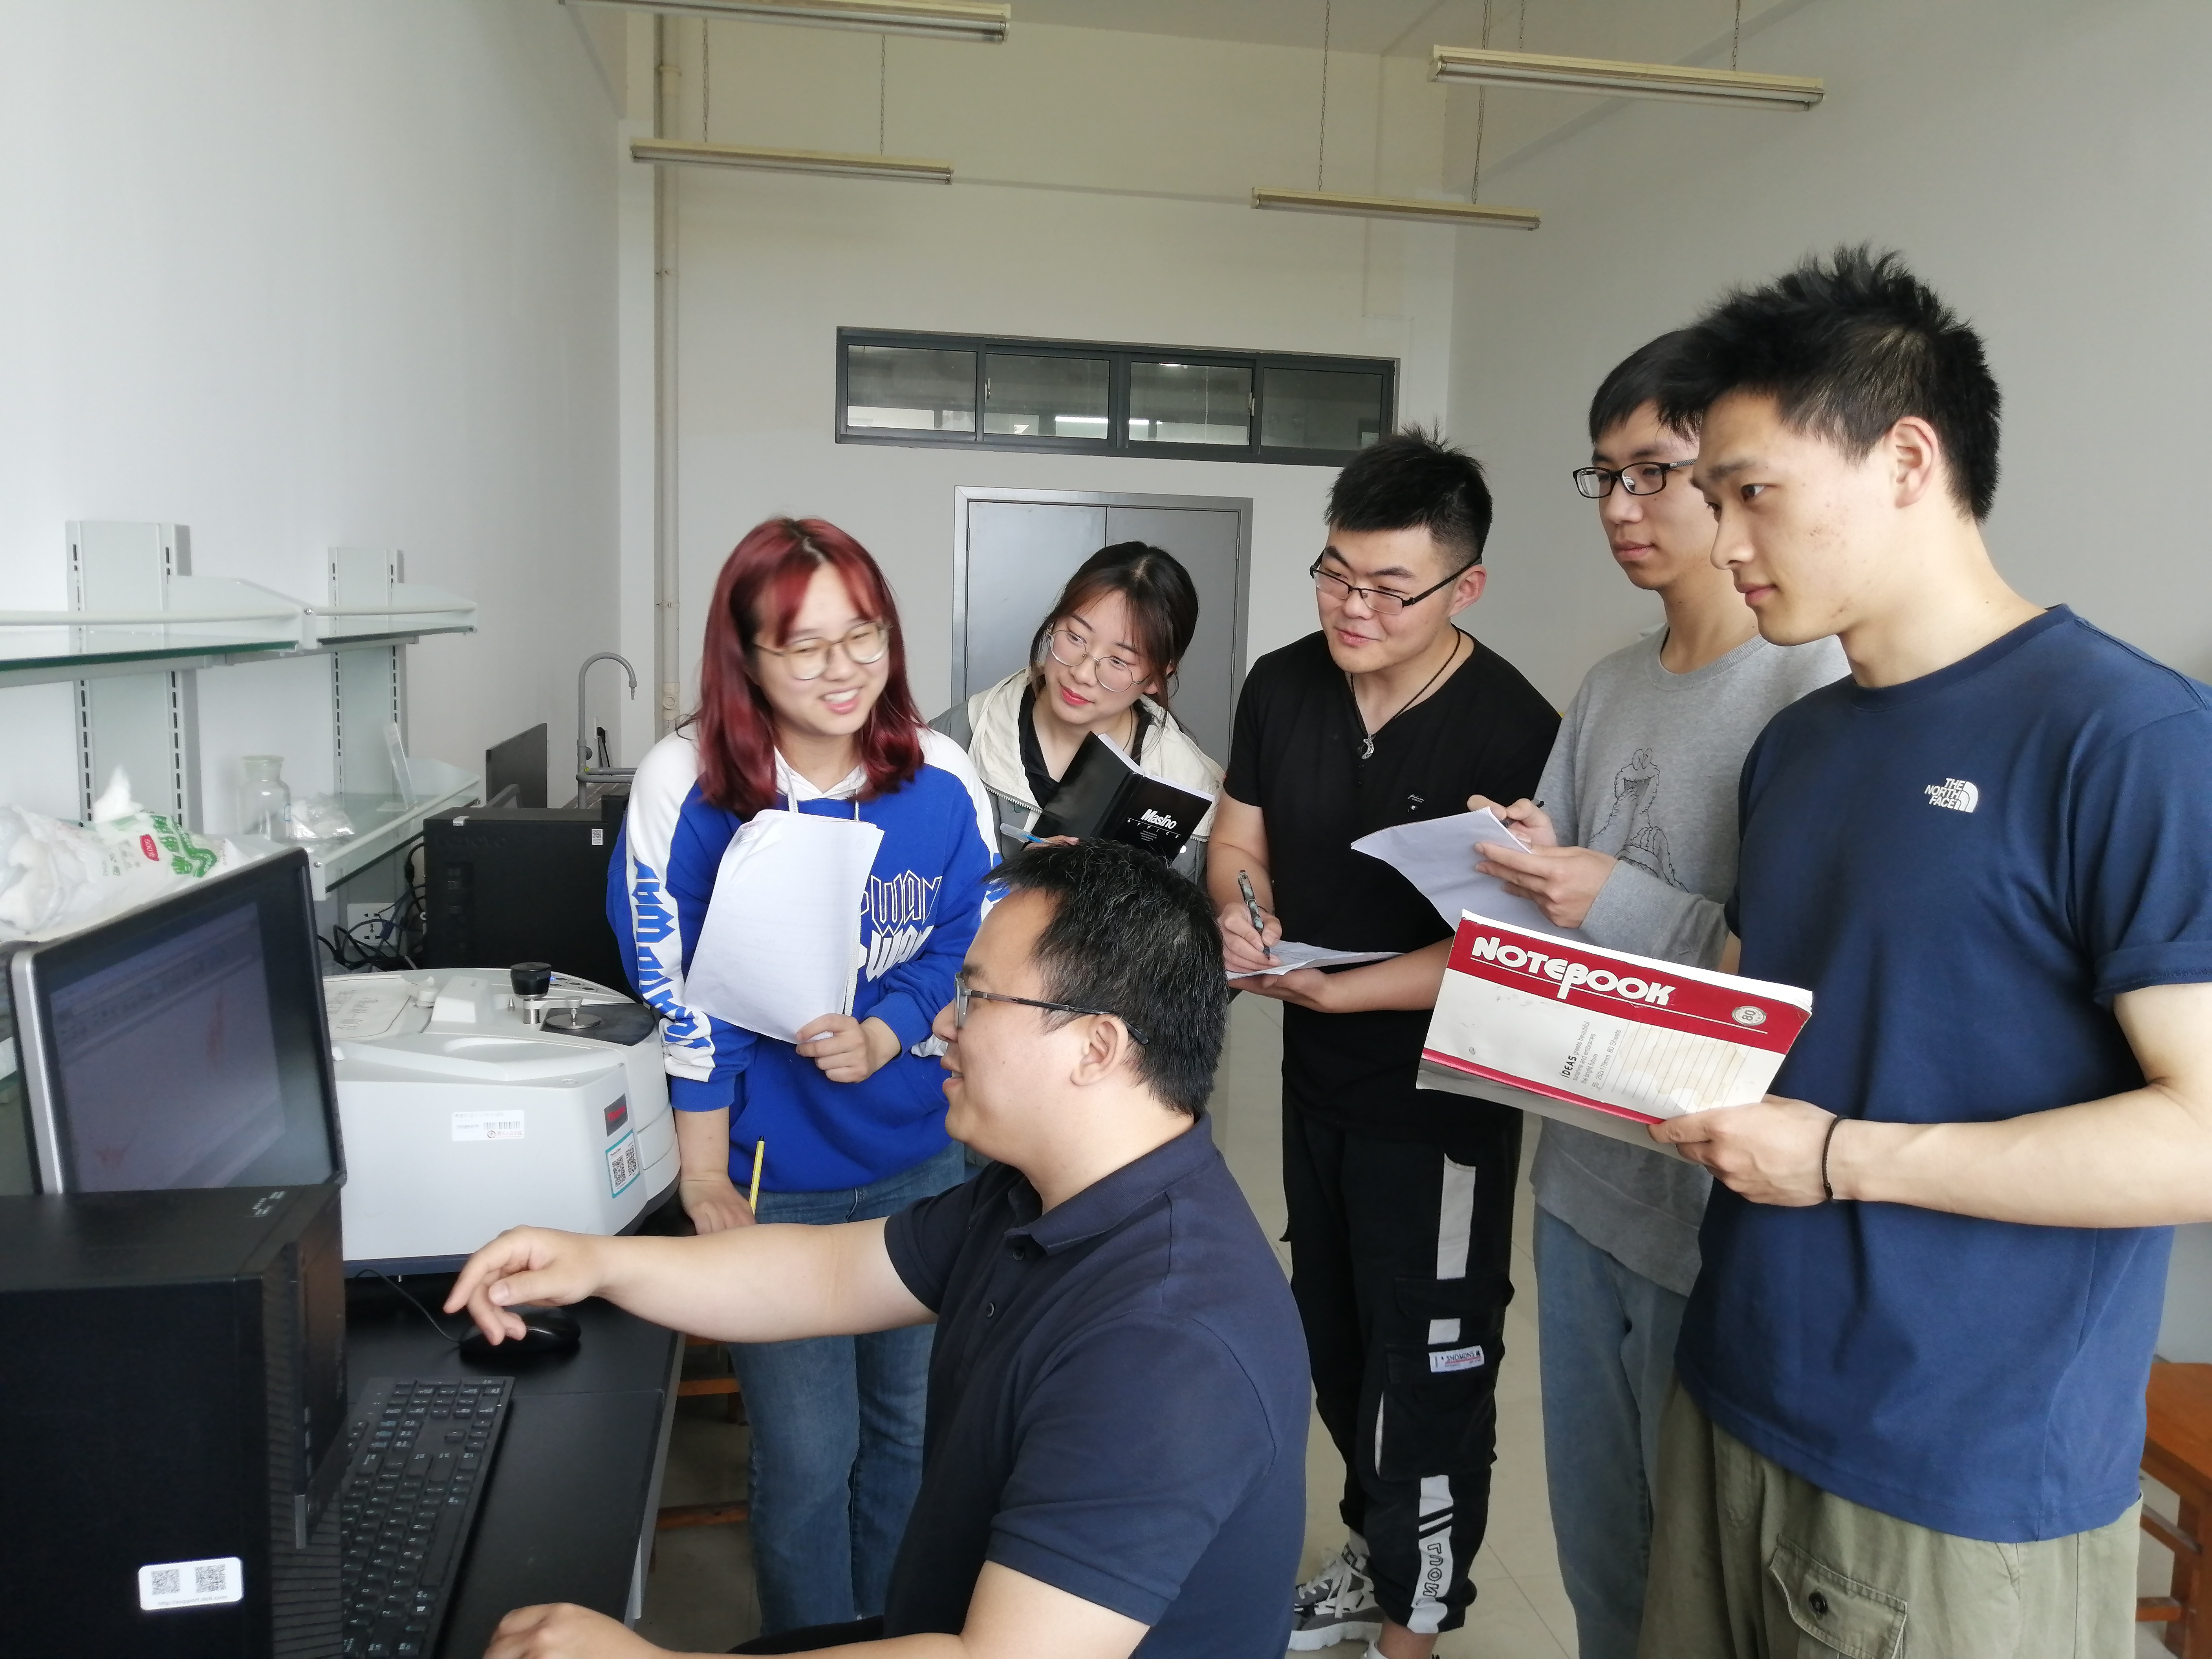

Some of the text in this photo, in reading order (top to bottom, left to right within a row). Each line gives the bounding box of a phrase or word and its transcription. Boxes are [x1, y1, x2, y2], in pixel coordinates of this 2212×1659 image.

[1945, 778, 1966, 789] THE
[1924, 785, 1962, 800] NORTH
[1928, 795, 1957, 809] FACE
[1471, 936, 1676, 1006] NOTEBOOK
[1741, 1010, 1756, 1021] 80
[1610, 1029, 1622, 1046] Sheets
[1559, 1055, 1577, 1078] IDEAS
